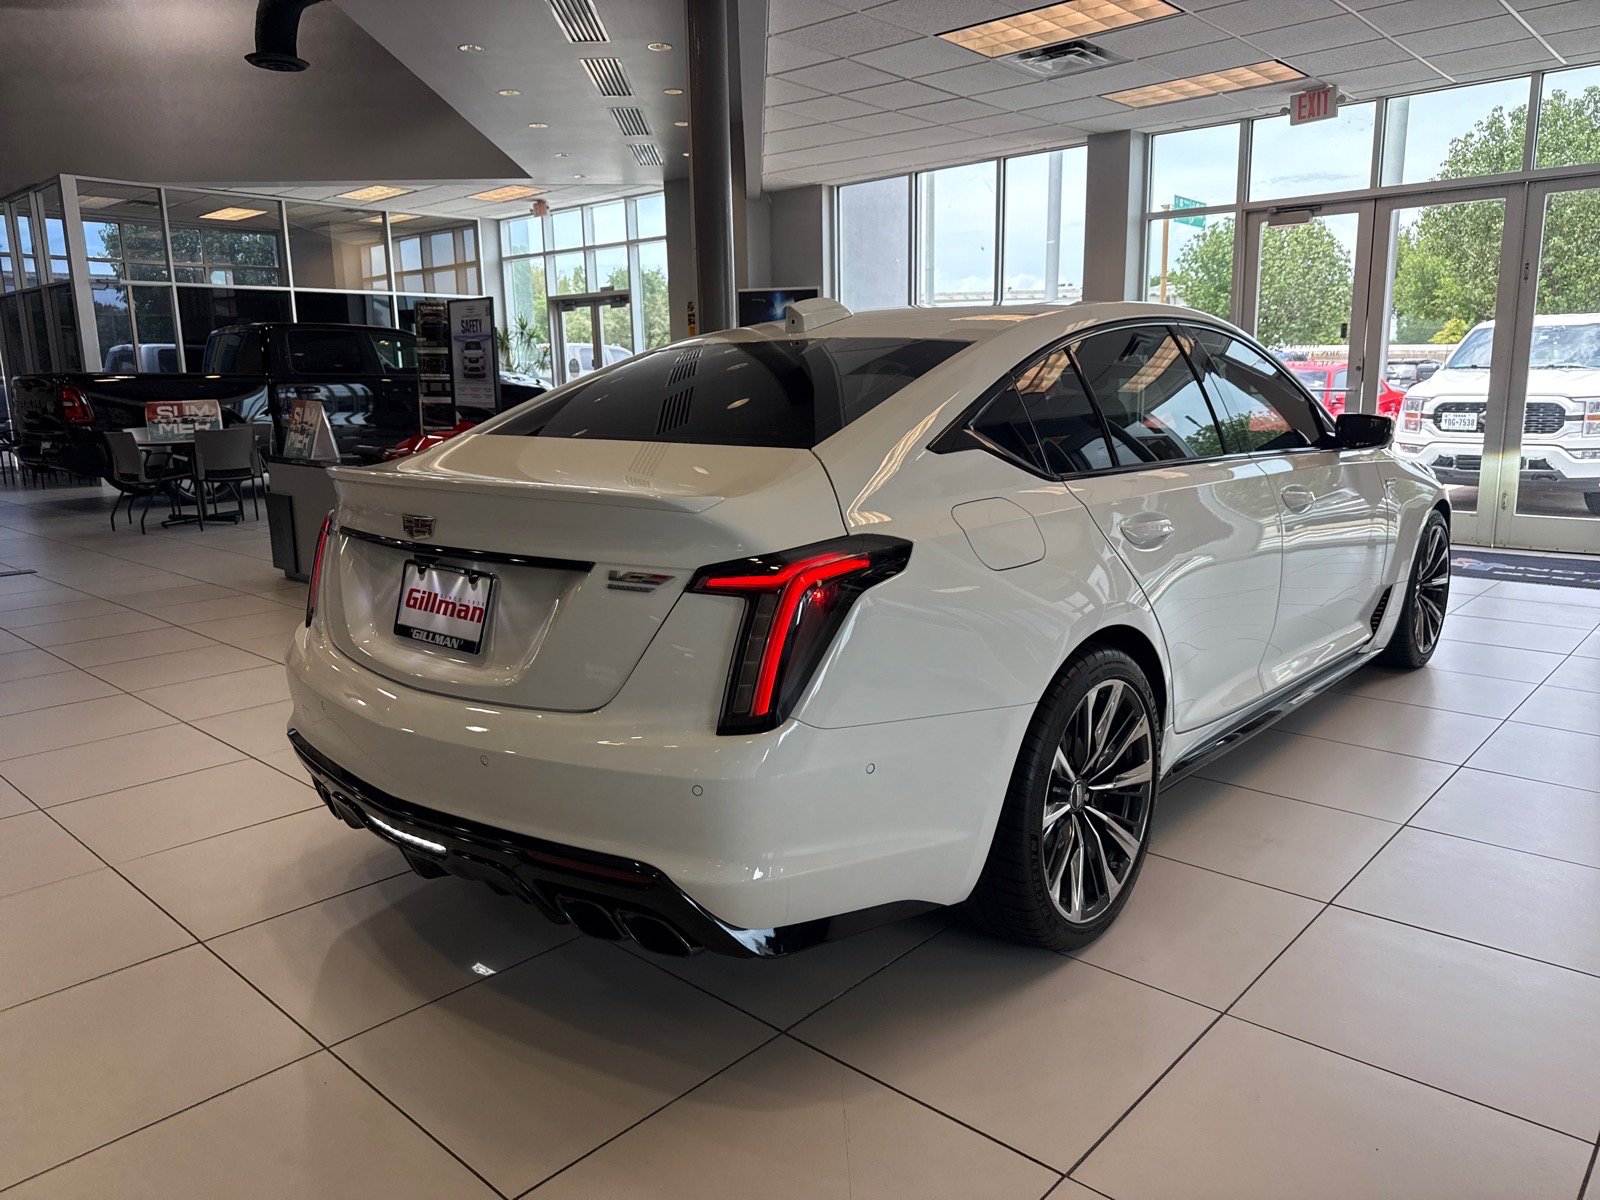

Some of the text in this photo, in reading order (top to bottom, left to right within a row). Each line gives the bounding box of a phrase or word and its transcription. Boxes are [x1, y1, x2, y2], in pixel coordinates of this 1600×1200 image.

[1297, 89, 1331, 120] EXIT
[460, 318, 482, 334] SAFETY
[405, 587, 485, 624] Gillman
[411, 628, 460, 649] GILLMAN
